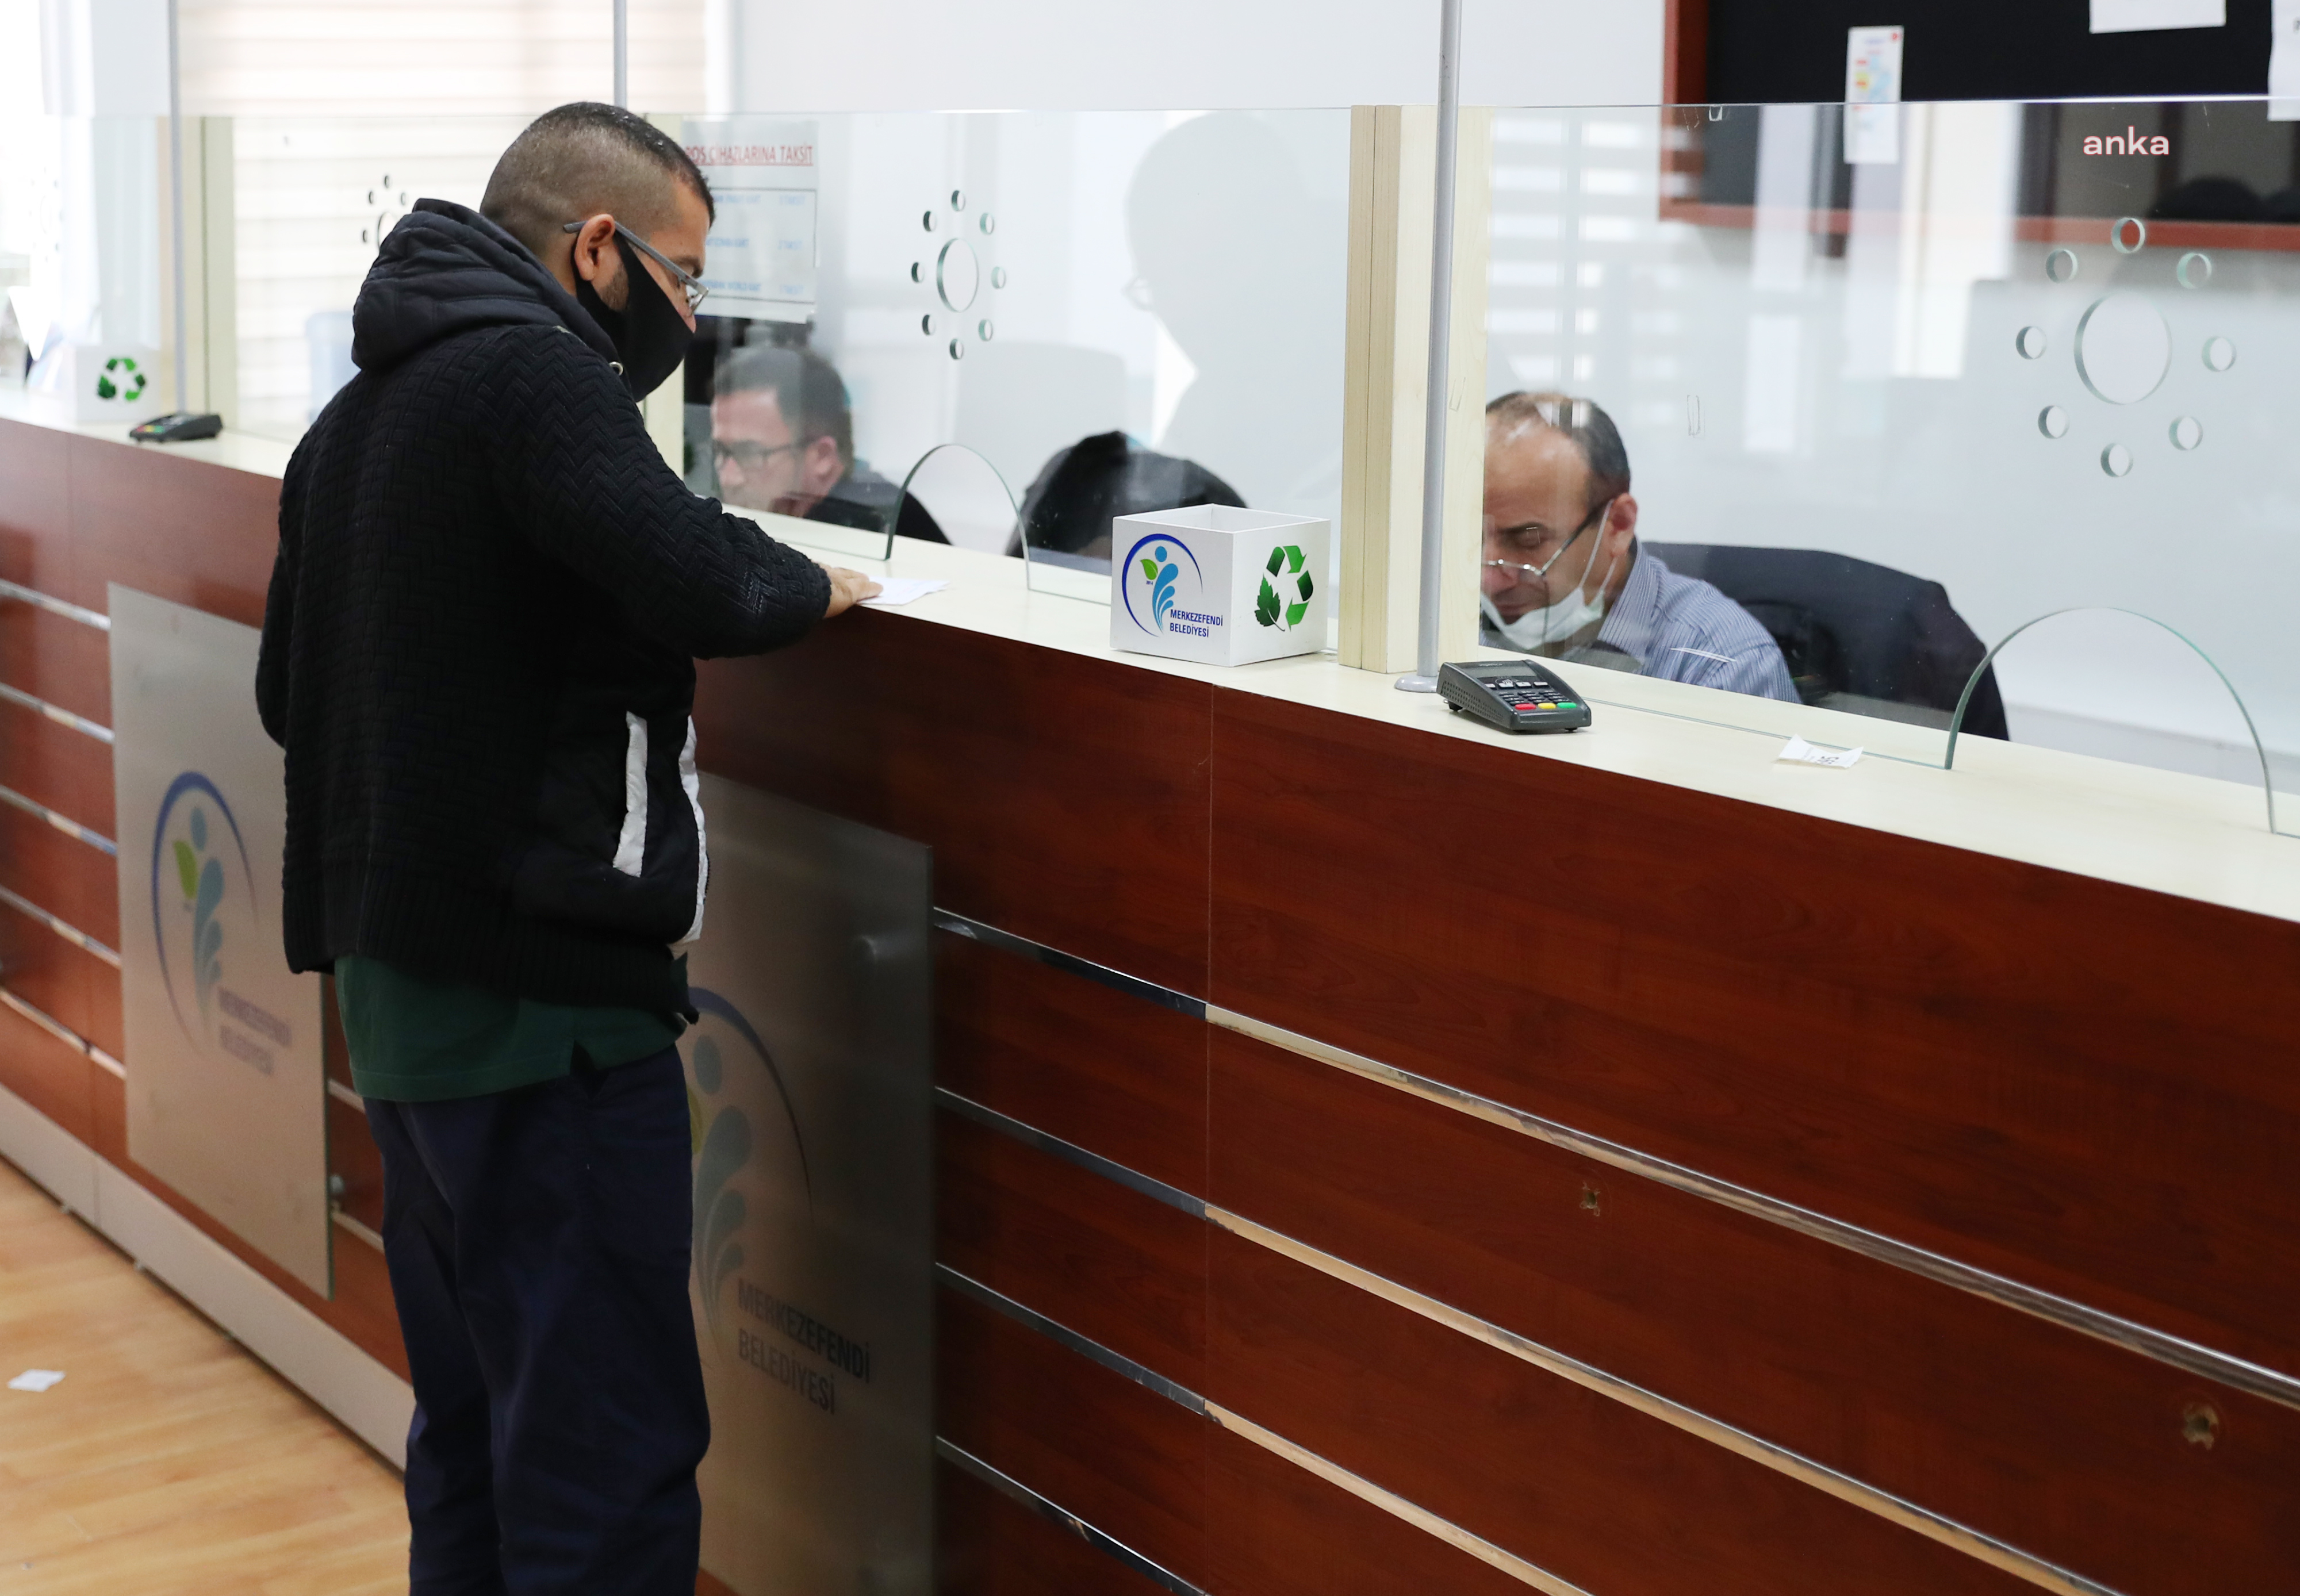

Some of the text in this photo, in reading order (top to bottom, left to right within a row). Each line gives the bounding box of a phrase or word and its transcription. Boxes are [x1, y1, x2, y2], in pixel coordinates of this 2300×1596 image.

[1170, 609, 1223, 627] MERKEZEFENDİ
[1170, 623, 1209, 638] BELEDİYESİ
[738, 1277, 870, 1384] MERKEZEFENDİ
[738, 1328, 835, 1415] BELEDİYESİ
